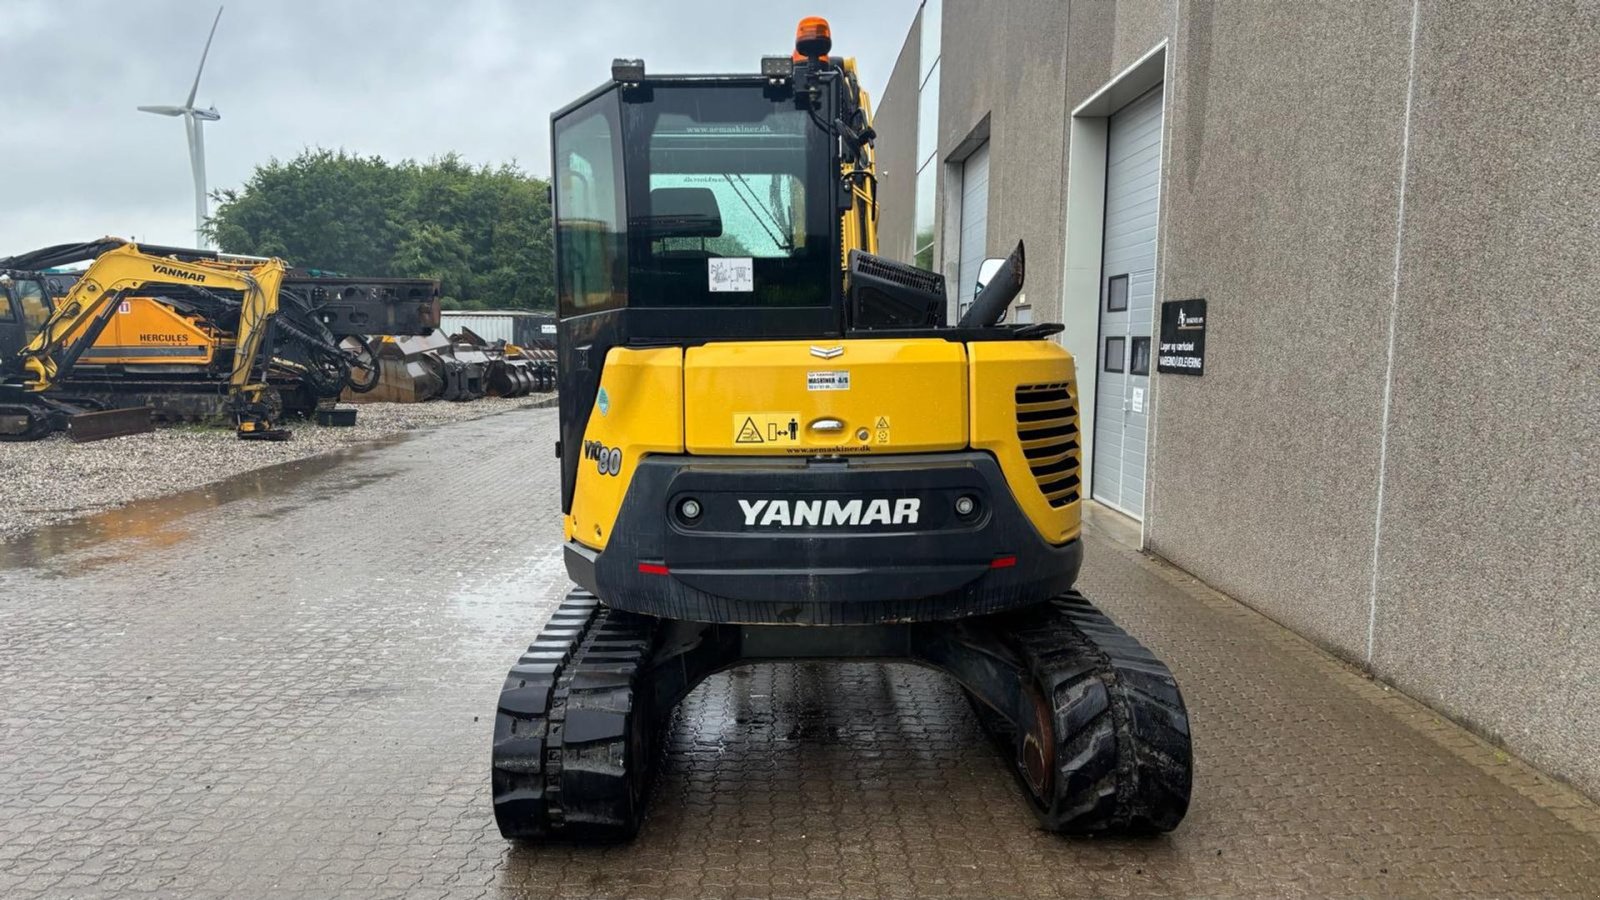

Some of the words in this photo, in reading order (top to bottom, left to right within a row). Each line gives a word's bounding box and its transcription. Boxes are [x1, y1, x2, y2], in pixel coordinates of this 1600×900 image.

[152, 264, 206, 282] YANMAR
[139, 333, 189, 342] HERCULES
[786, 445, 871, 454] www.aemaskiner.dk
[597, 446, 622, 477] 80
[737, 497, 921, 526] YANMAR
